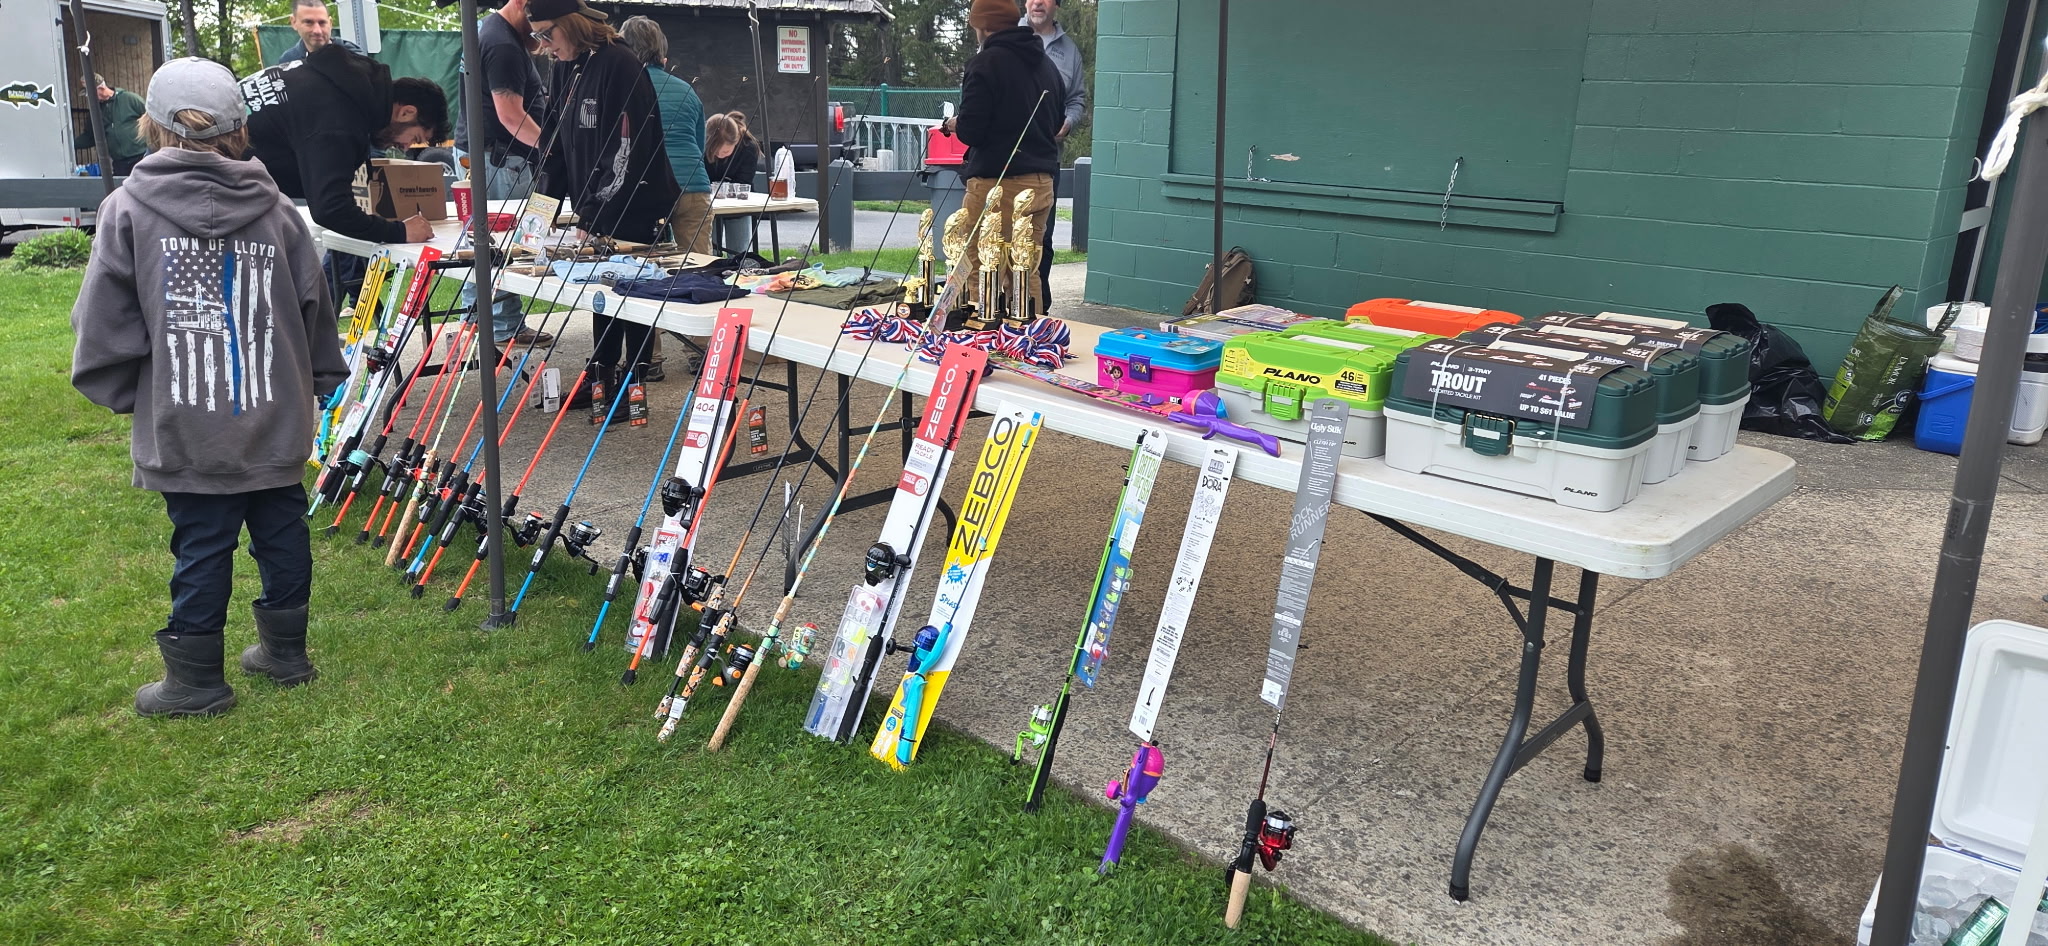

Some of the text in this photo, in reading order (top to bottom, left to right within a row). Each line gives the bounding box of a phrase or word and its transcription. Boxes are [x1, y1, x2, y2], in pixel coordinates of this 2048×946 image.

[160, 237, 276, 258] TOWN OF LLOYD
[402, 261, 425, 313] ZEBCO
[350, 253, 379, 339] ZEBCO
[702, 327, 726, 395] ZEBCO
[1430, 361, 1492, 375] PLANO 3-TRAY
[1263, 367, 1321, 385] PLANO
[1341, 371, 1355, 382] 46
[1431, 369, 1487, 394] TROUT
[1538, 373, 1572, 385] 41 PIECES
[925, 368, 956, 440] ZEBCO
[1455, 391, 1473, 400] TACKLE
[695, 402, 714, 413] 404
[1520, 403, 1576, 420] UP TO $61 VALUE
[914, 443, 936, 454] READY
[954, 416, 1013, 556] ZEBCO
[1202, 475, 1222, 492] DORA
[1563, 486, 1598, 497] PLANO
